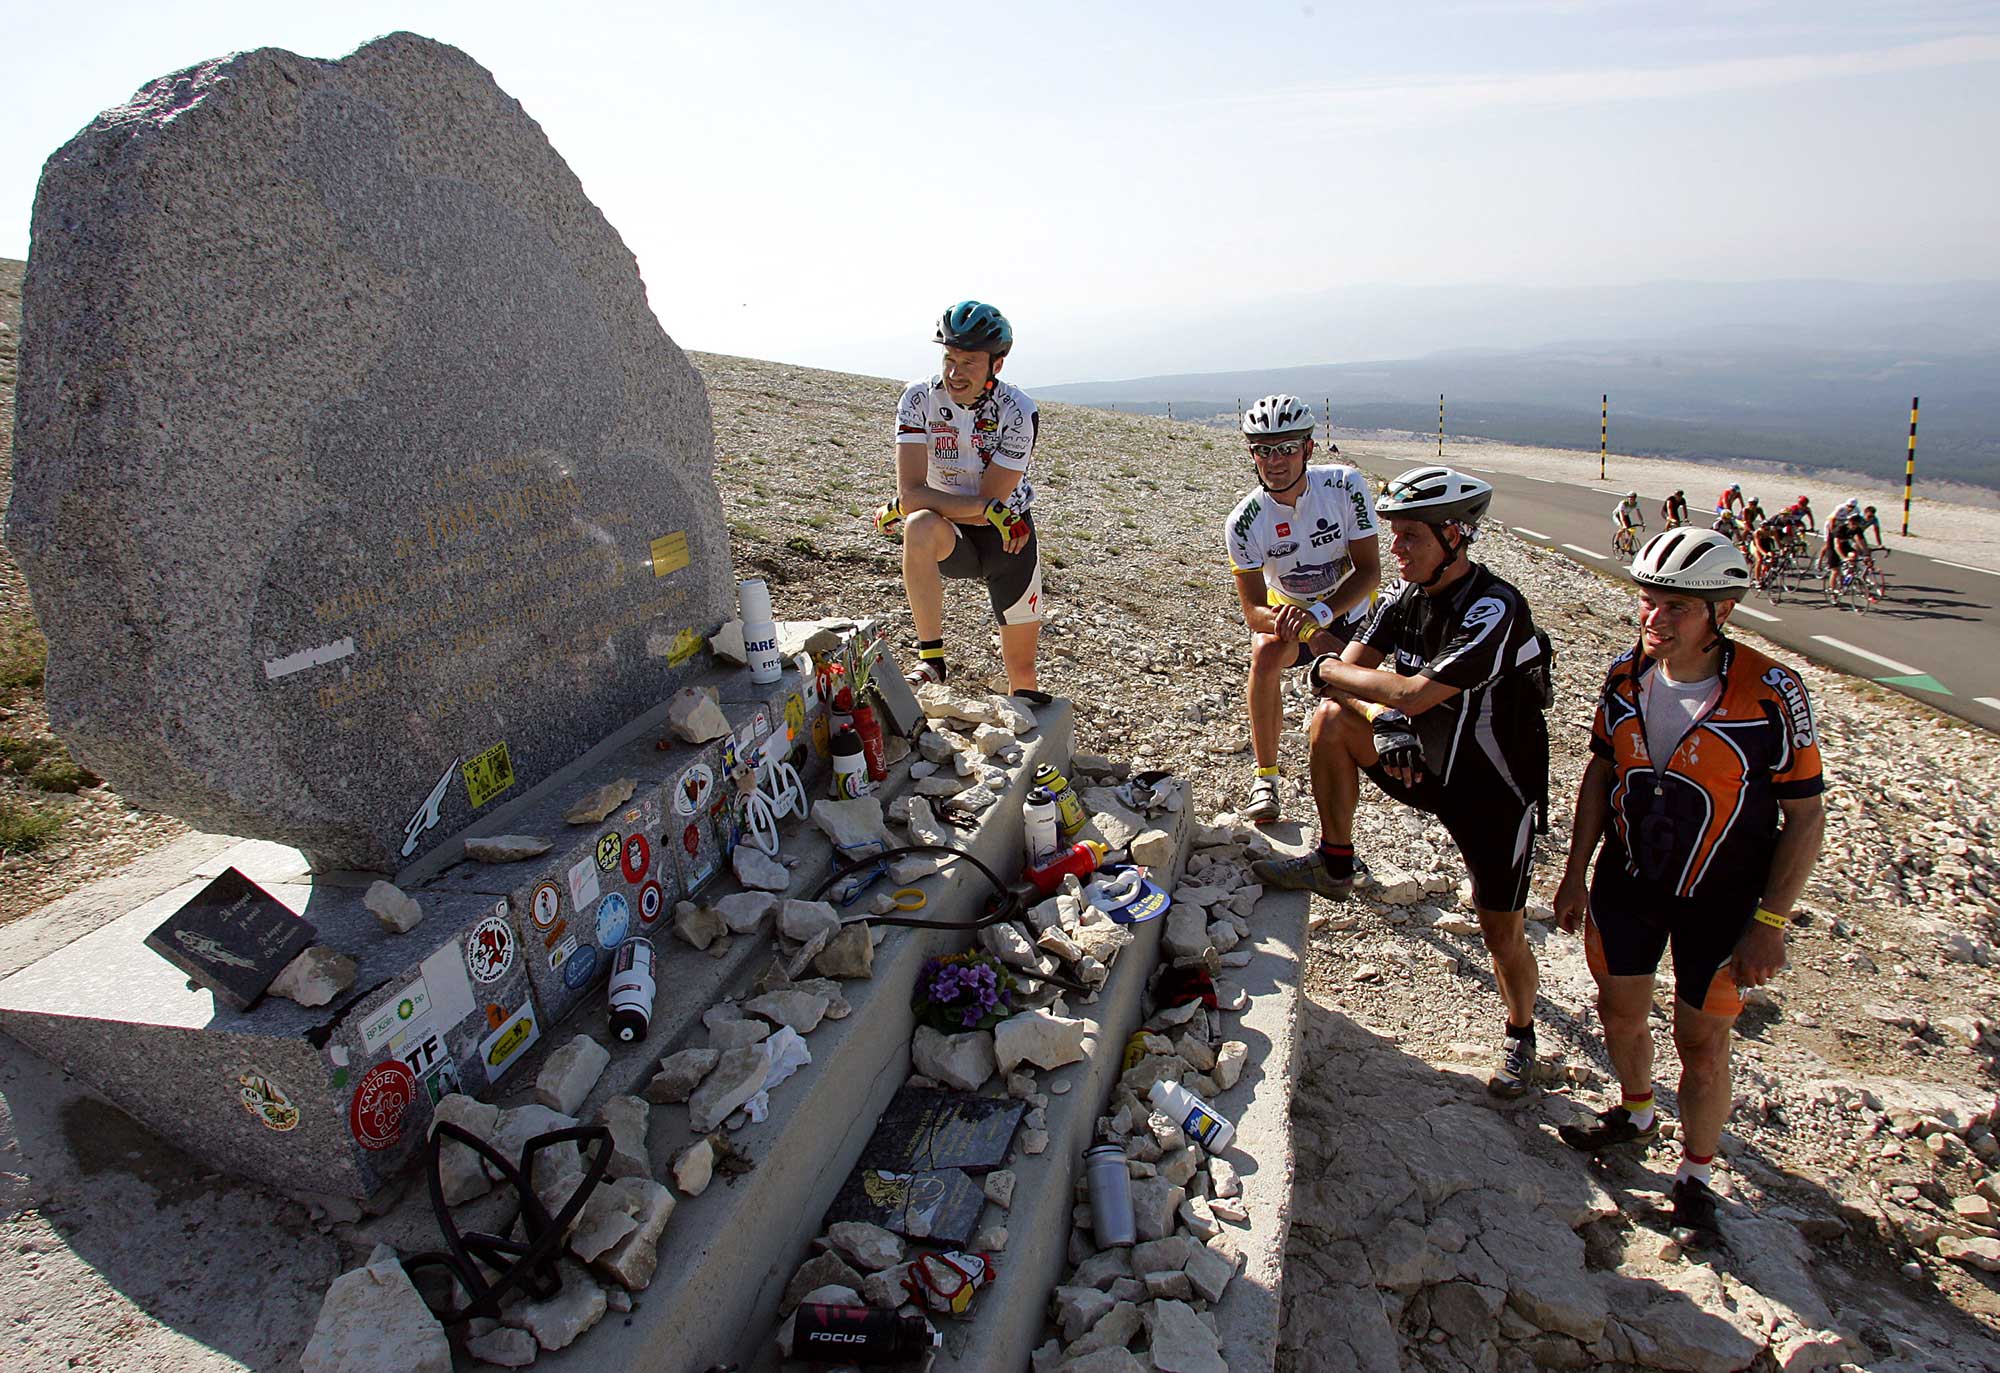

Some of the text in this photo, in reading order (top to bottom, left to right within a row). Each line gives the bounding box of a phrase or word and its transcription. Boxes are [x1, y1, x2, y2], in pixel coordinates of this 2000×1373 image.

[909, 390, 926, 410] van
[997, 388, 1016, 408] van
[1010, 408, 1023, 433] roy
[936, 436, 957, 448] ROCK
[1234, 498, 1262, 542] SPORTA
[1351, 491, 1373, 531] SPORTA
[423, 503, 481, 549] TOM
[1311, 530, 1342, 548] KBC
[1269, 544, 1293, 556] Ford
[745, 638, 775, 652] CARE
[809, 1332, 867, 1344] FOCUS
